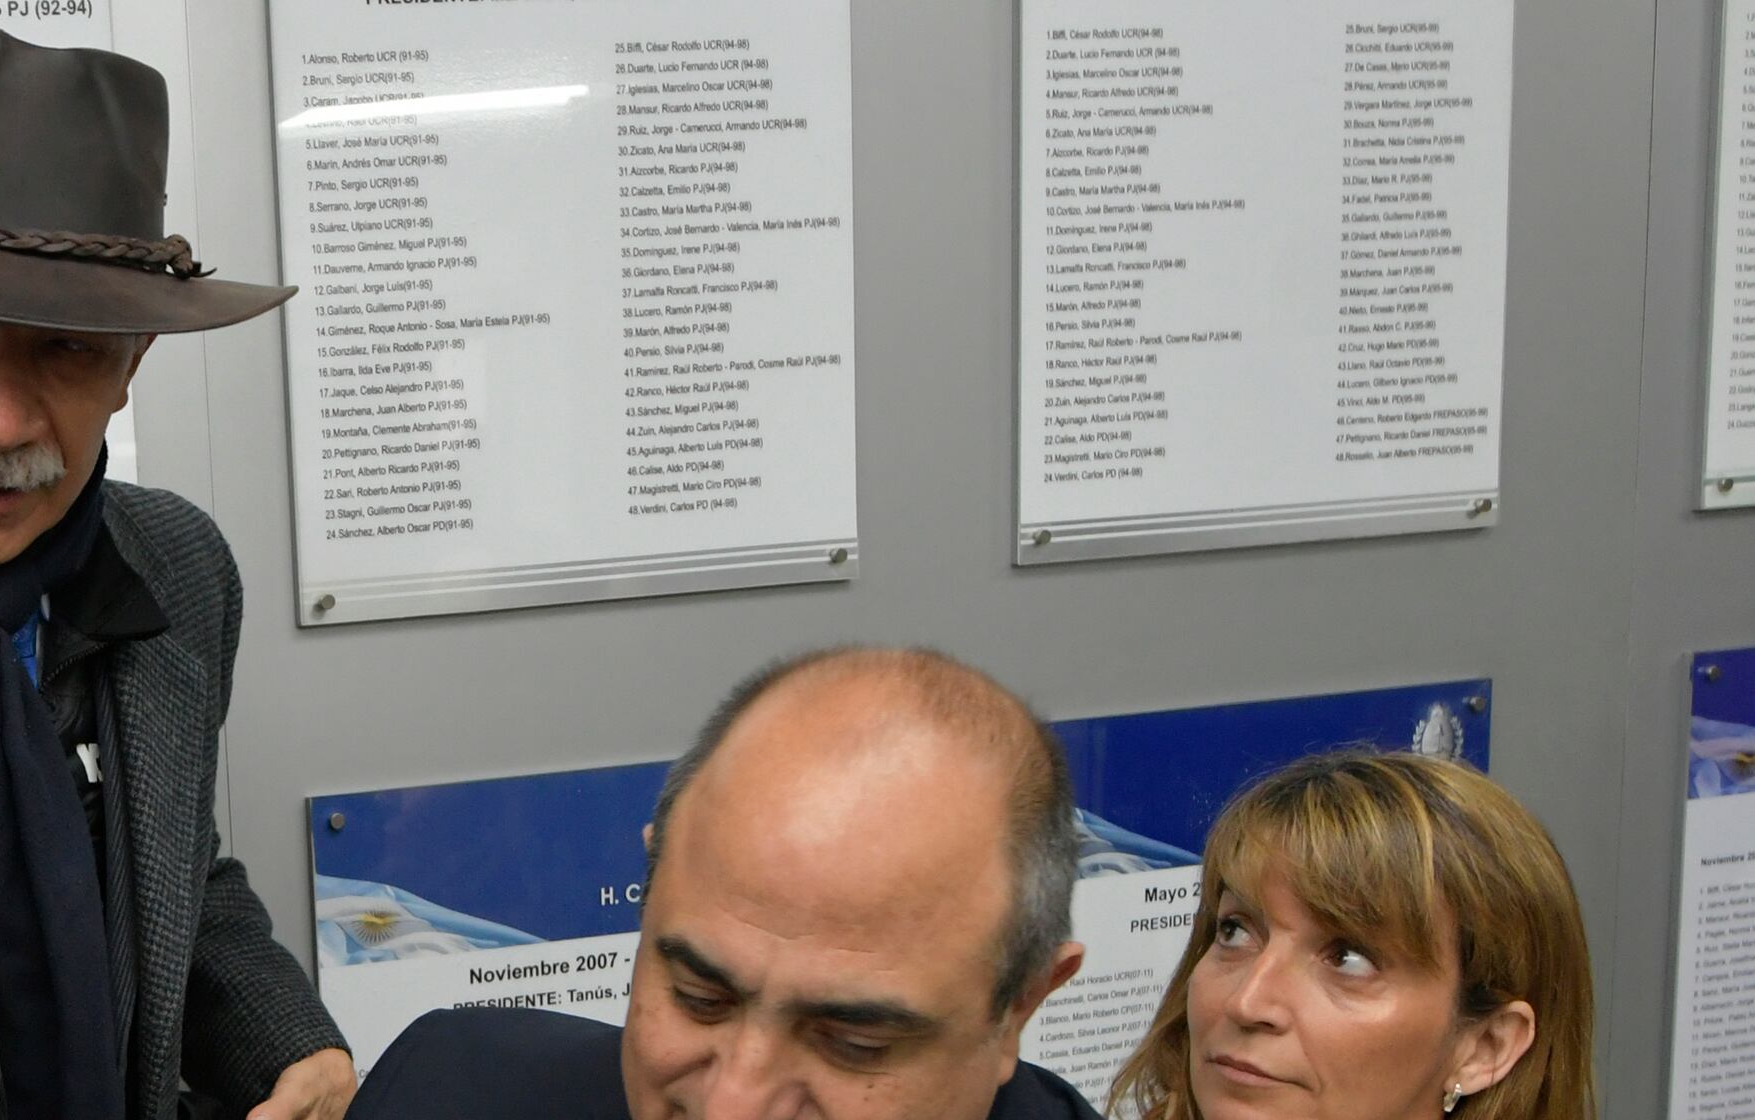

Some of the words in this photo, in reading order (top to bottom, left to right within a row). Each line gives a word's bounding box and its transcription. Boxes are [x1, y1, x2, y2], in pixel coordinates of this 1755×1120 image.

[7, 0, 29, 17] PJ
[33, 0, 92, 19] (92-94)
[600, 886, 620, 906] H.
[1144, 886, 1188, 905] Mayo
[1130, 912, 1196, 933] PRESIDE
[469, 960, 570, 984] Noviembre
[575, 951, 618, 972] 2007
[567, 985, 618, 1004] Tanús,
